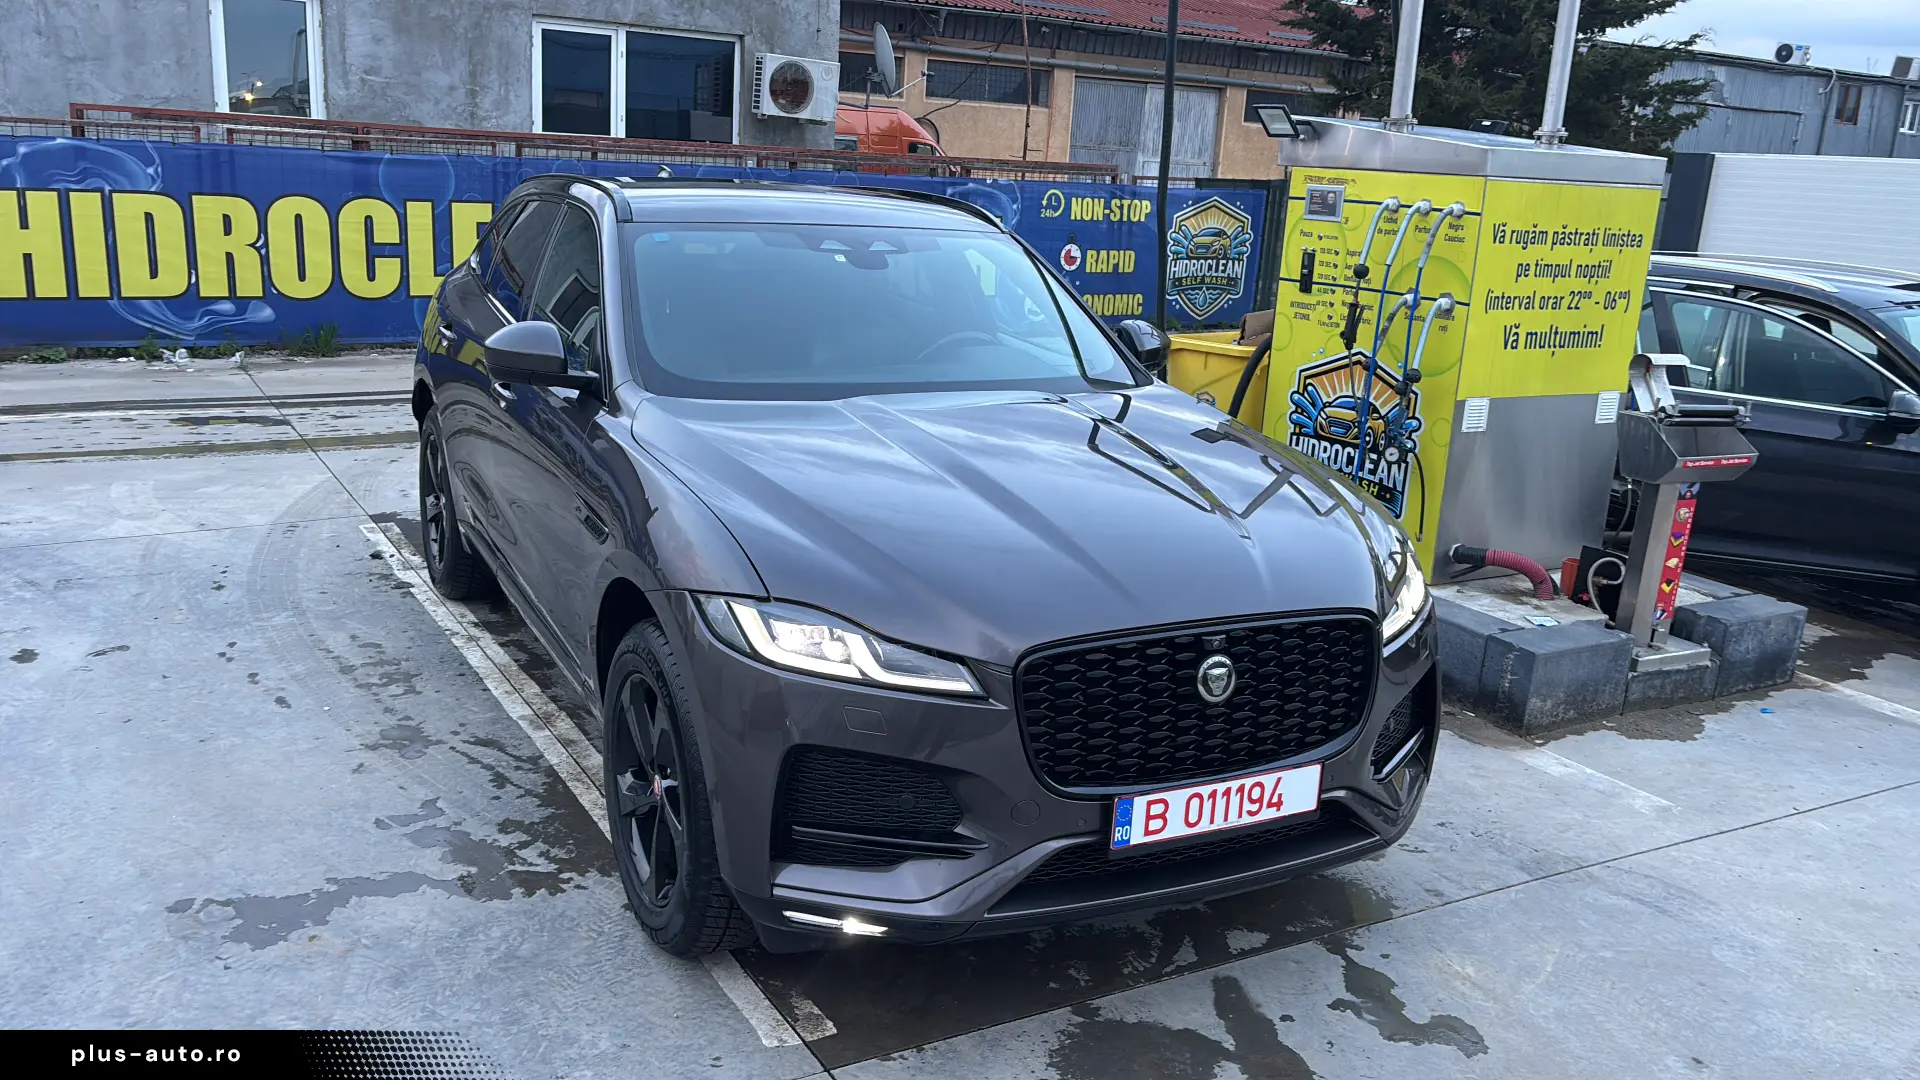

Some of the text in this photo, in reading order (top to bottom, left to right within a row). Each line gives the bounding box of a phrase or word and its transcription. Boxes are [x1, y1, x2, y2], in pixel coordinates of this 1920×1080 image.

[1040, 209, 1055, 218] 24h
[1070, 197, 1152, 222] NON-STOP
[1414, 225, 1432, 234] Parfu
[1492, 222, 1643, 254] Vă rugăm păstrați liniștea
[0, 189, 493, 299] HIDROCLE
[1085, 249, 1136, 273] RAPID
[1170, 259, 1243, 279] HIDROCLEAN
[1515, 258, 1613, 285] pe timpul nopții!
[1182, 276, 1228, 286] SELF WASH
[1082, 293, 1143, 316] ONOMIC
[1484, 289, 1536, 314] (interval
[1538, 294, 1564, 310] orar
[1503, 322, 1605, 357] Vă mulțumim!
[1143, 776, 1284, 838] B 011194
[1114, 825, 1130, 842] RO
